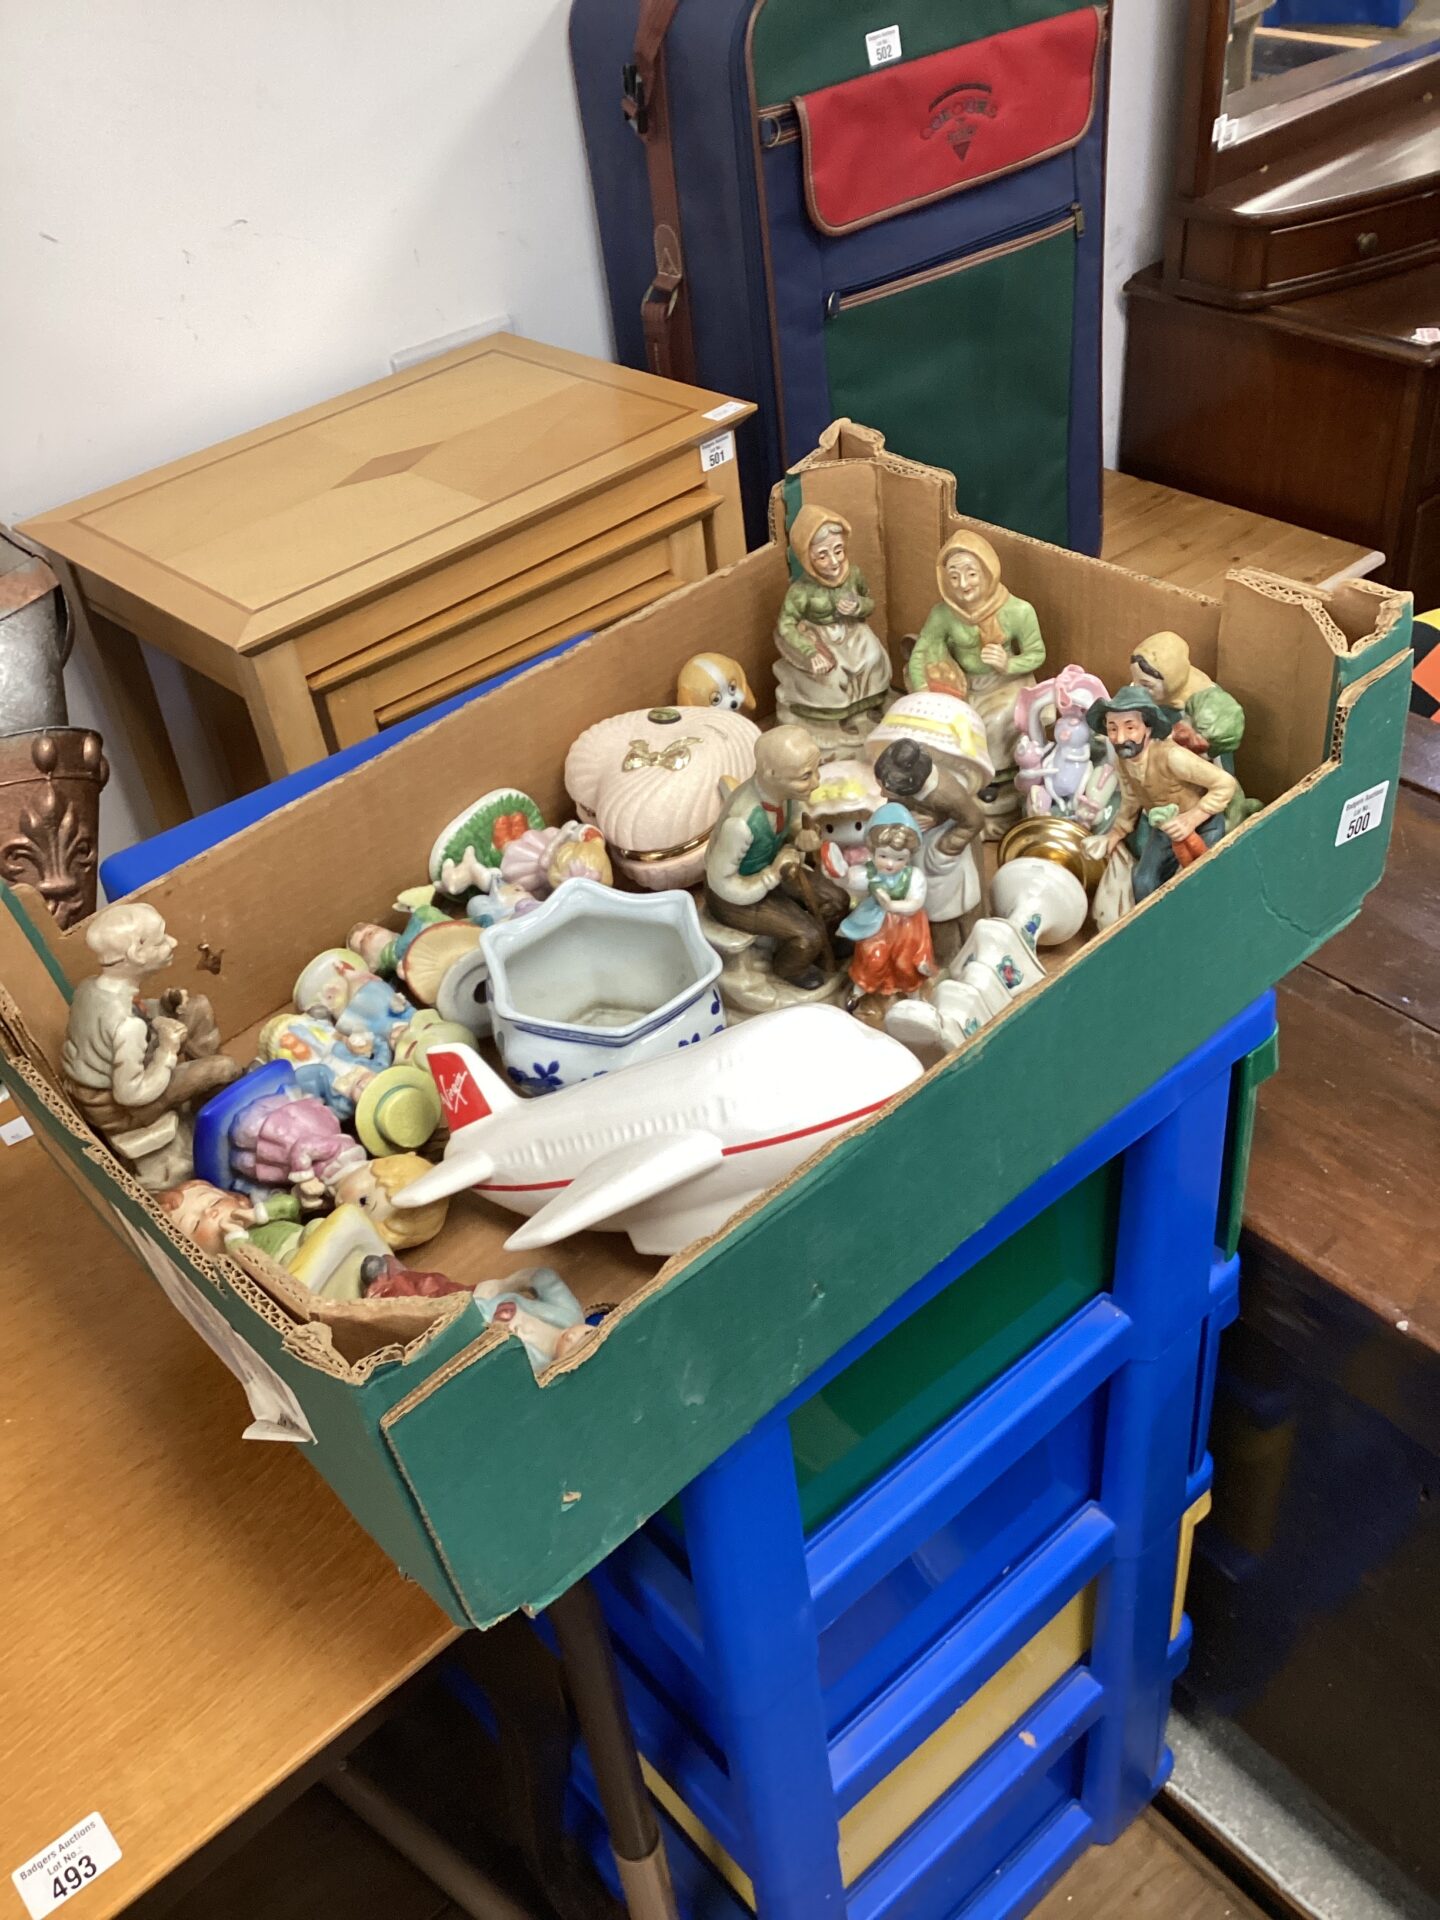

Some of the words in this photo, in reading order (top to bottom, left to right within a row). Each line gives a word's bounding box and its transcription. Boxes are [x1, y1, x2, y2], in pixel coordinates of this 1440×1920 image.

[876, 44, 893, 61] 502
[709, 450, 725, 467] 501
[1346, 812, 1370, 839] 500
[439, 1071, 469, 1114] Virgin
[19, 1850, 57, 1880] Badgers
[58, 1821, 96, 1852] Auctions
[46, 1861, 62, 1876] Lot
[53, 1855, 97, 1899] 493
